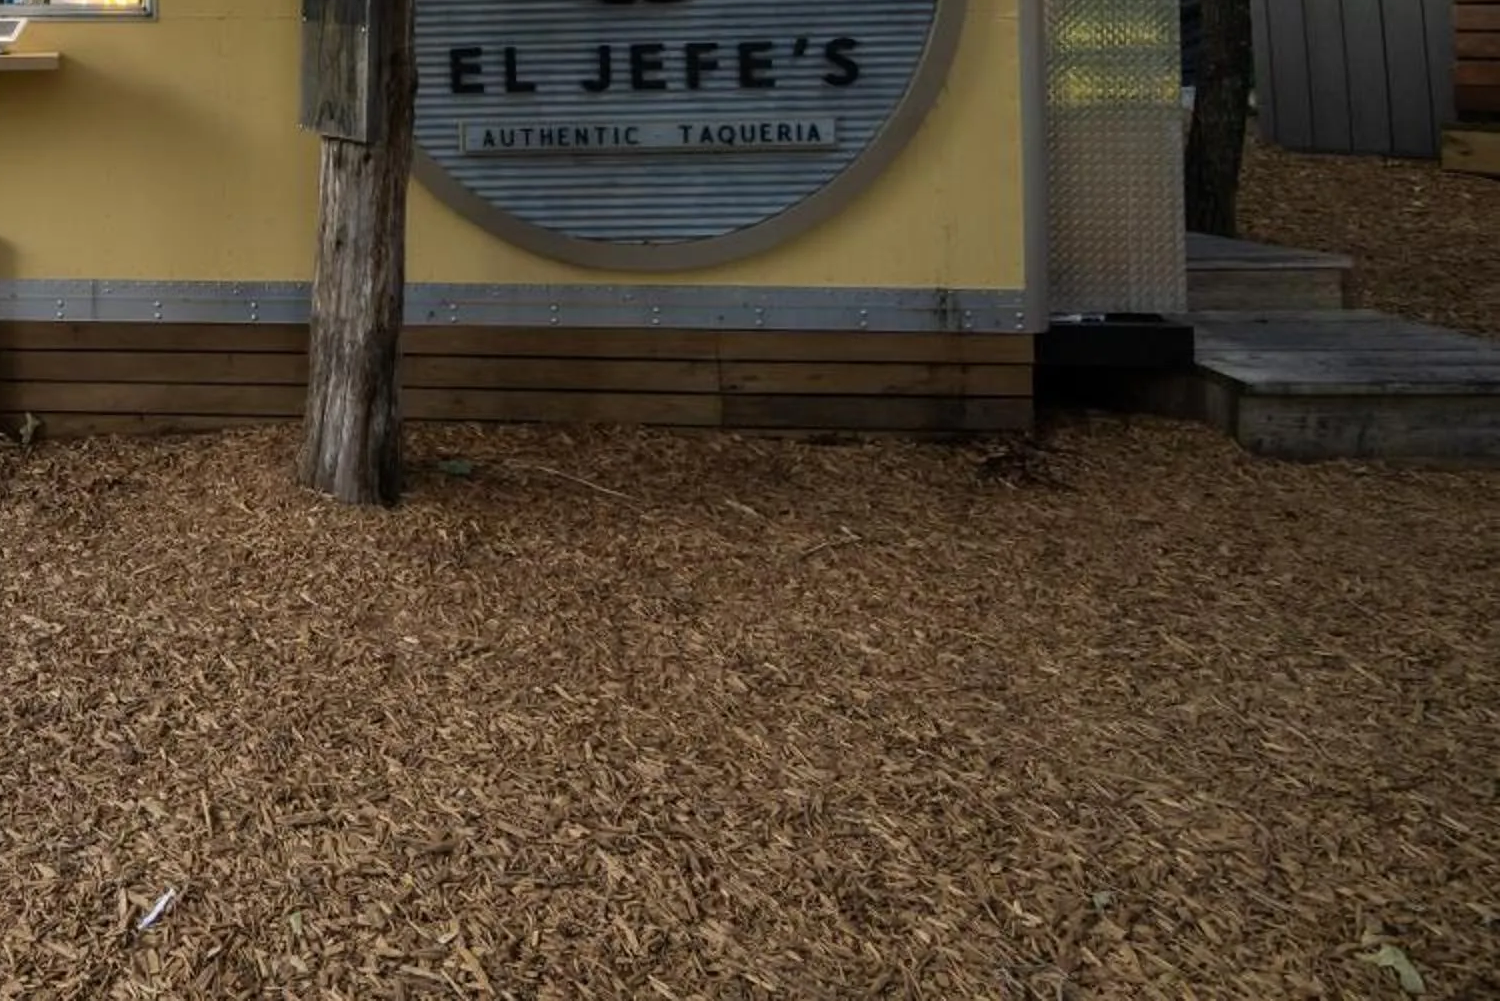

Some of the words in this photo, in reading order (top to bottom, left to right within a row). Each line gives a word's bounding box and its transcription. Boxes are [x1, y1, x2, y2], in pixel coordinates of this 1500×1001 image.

[450, 46, 536, 93] EL
[580, 37, 860, 91] JEFE'S
[483, 126, 640, 148] AUTHENTIC
[678, 123, 821, 146] TAQUERIA
